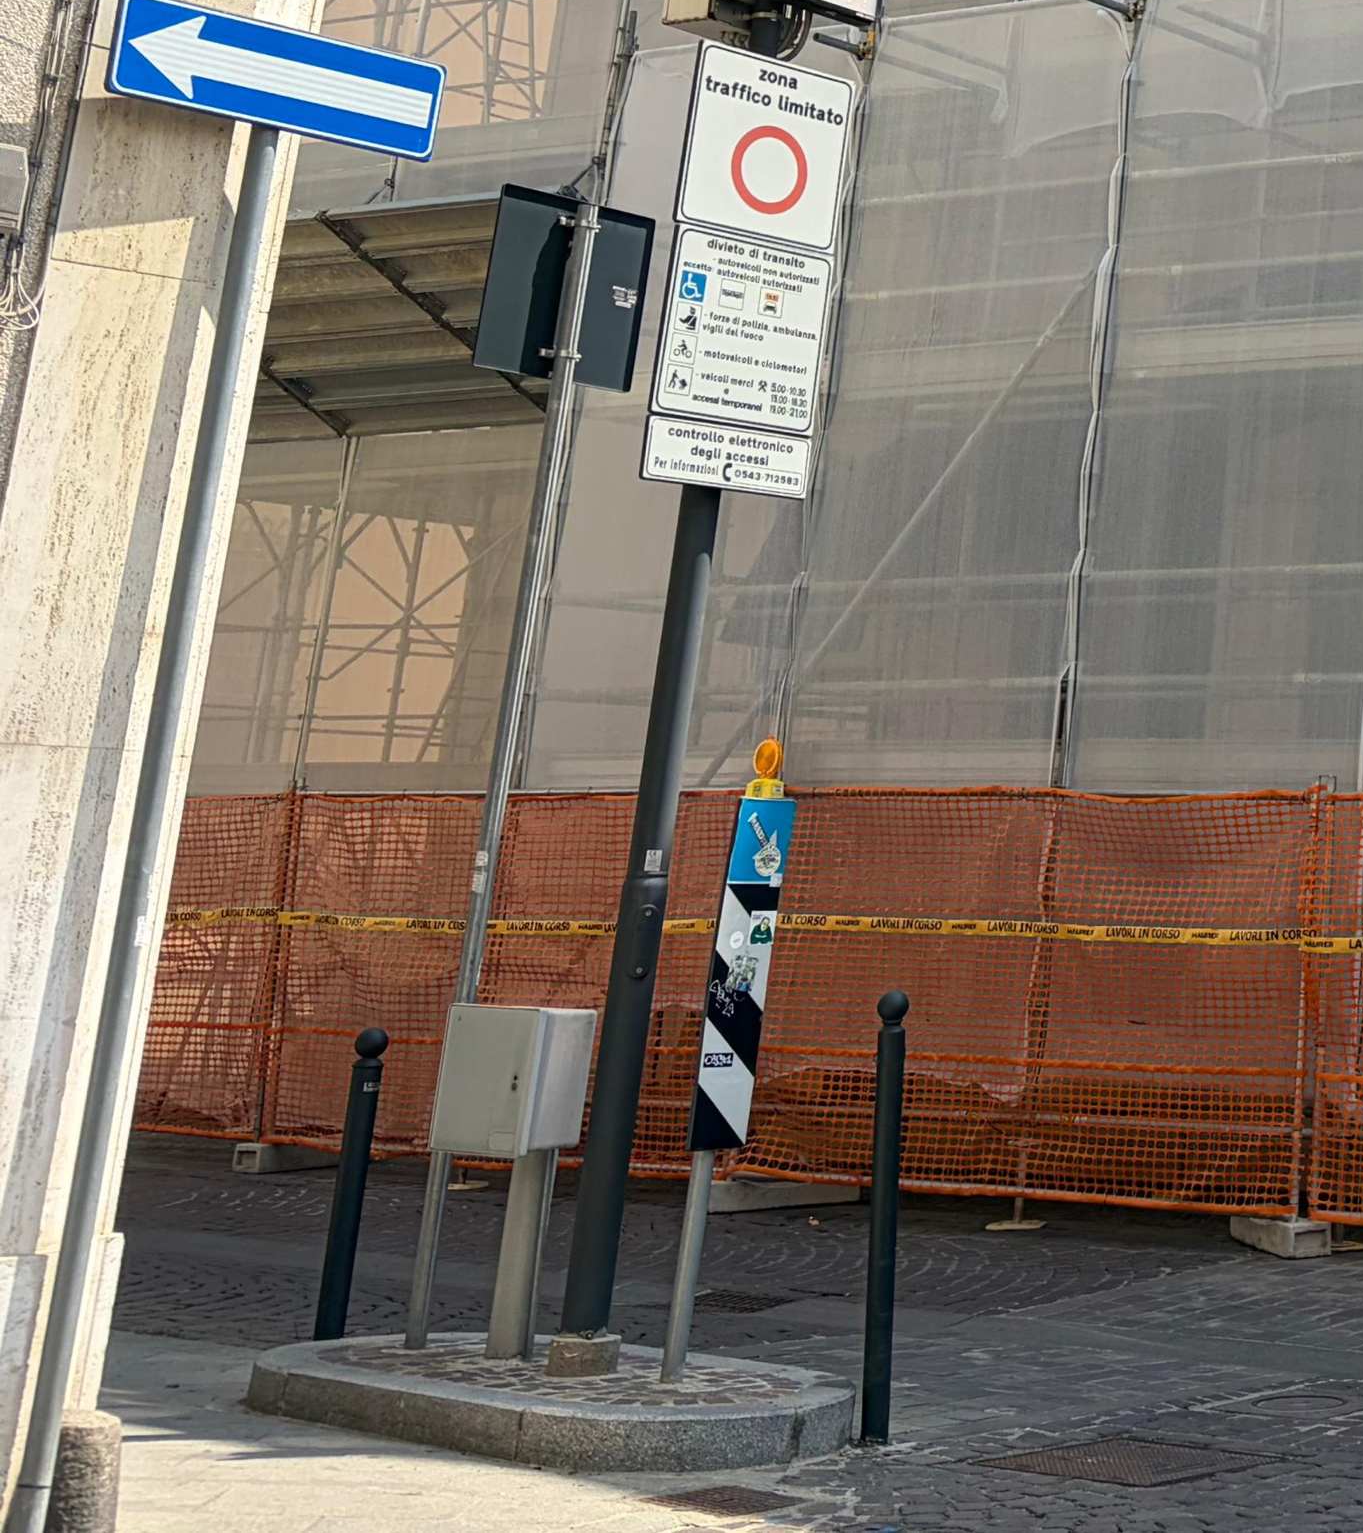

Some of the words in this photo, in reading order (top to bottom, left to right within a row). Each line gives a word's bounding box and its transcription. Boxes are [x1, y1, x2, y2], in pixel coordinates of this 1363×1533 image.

[758, 69, 798, 90] zona
[705, 75, 772, 107] traffico
[778, 94, 844, 126] limitato
[707, 239, 745, 256] divieto
[749, 249, 759, 260] di
[762, 251, 805, 269] transito
[683, 260, 713, 273] eccetto
[717, 268, 761, 284] autoveicoli
[762, 278, 803, 293] autorizzati
[718, 257, 762, 273] autoveicoli
[763, 267, 778, 277] non
[779, 271, 820, 286] autorizzati
[709, 311, 730, 324] forze
[732, 315, 741, 326] di
[740, 329, 765, 343] fuoco
[704, 349, 753, 366] motoveicoli
[761, 360, 808, 376] ciclomotori
[701, 372, 729, 384] veicoli
[668, 426, 725, 444] controllo
[728, 435, 794, 454] elettronico
[654, 456, 668, 468] Per
[670, 458, 719, 477] informazioni
[690, 445, 721, 462] degli
[725, 450, 770, 467] accessi
[781, 916, 793, 924] IN
[795, 916, 827, 925] CORSO
[870, 919, 900, 928] LAVORI
[902, 920, 913, 929] IN
[914, 920, 942, 930] CORSO
[987, 922, 1017, 932] LAVORI
[1019, 922, 1033, 932] IN
[1034, 922, 1059, 934] CORSO
[1106, 927, 1136, 938] LAVORI
[1138, 929, 1149, 938] IN
[1152, 929, 1180, 939] CORSO
[1229, 931, 1263, 941] LAVORI
[1266, 930, 1279, 940] IN
